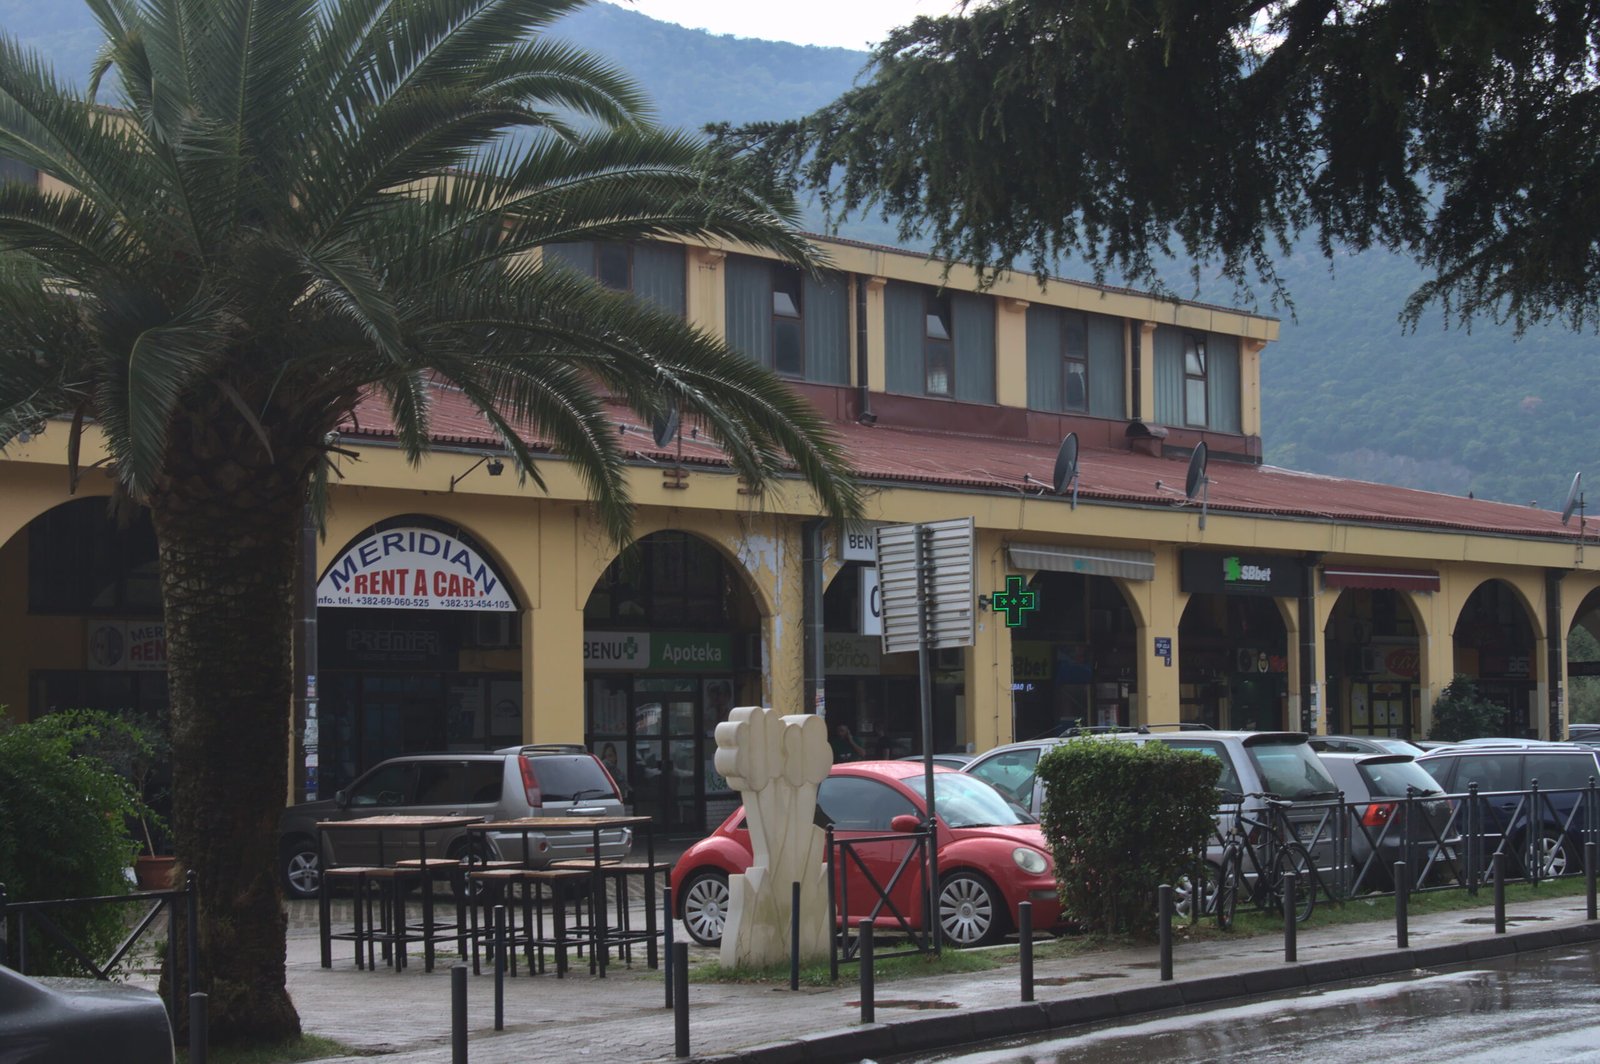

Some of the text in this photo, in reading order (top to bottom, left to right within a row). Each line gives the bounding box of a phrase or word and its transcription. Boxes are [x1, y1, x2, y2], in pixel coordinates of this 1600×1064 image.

[849, 534, 873, 550] BEN
[329, 531, 497, 596] MERIDIAN
[1241, 565, 1271, 582] SBbet
[353, 568, 476, 598] RENT A CAR
[317, 595, 511, 609] nfo. tel. +382-69-060-525 +382-33-454-105
[662, 641, 722, 665] Apoteka
